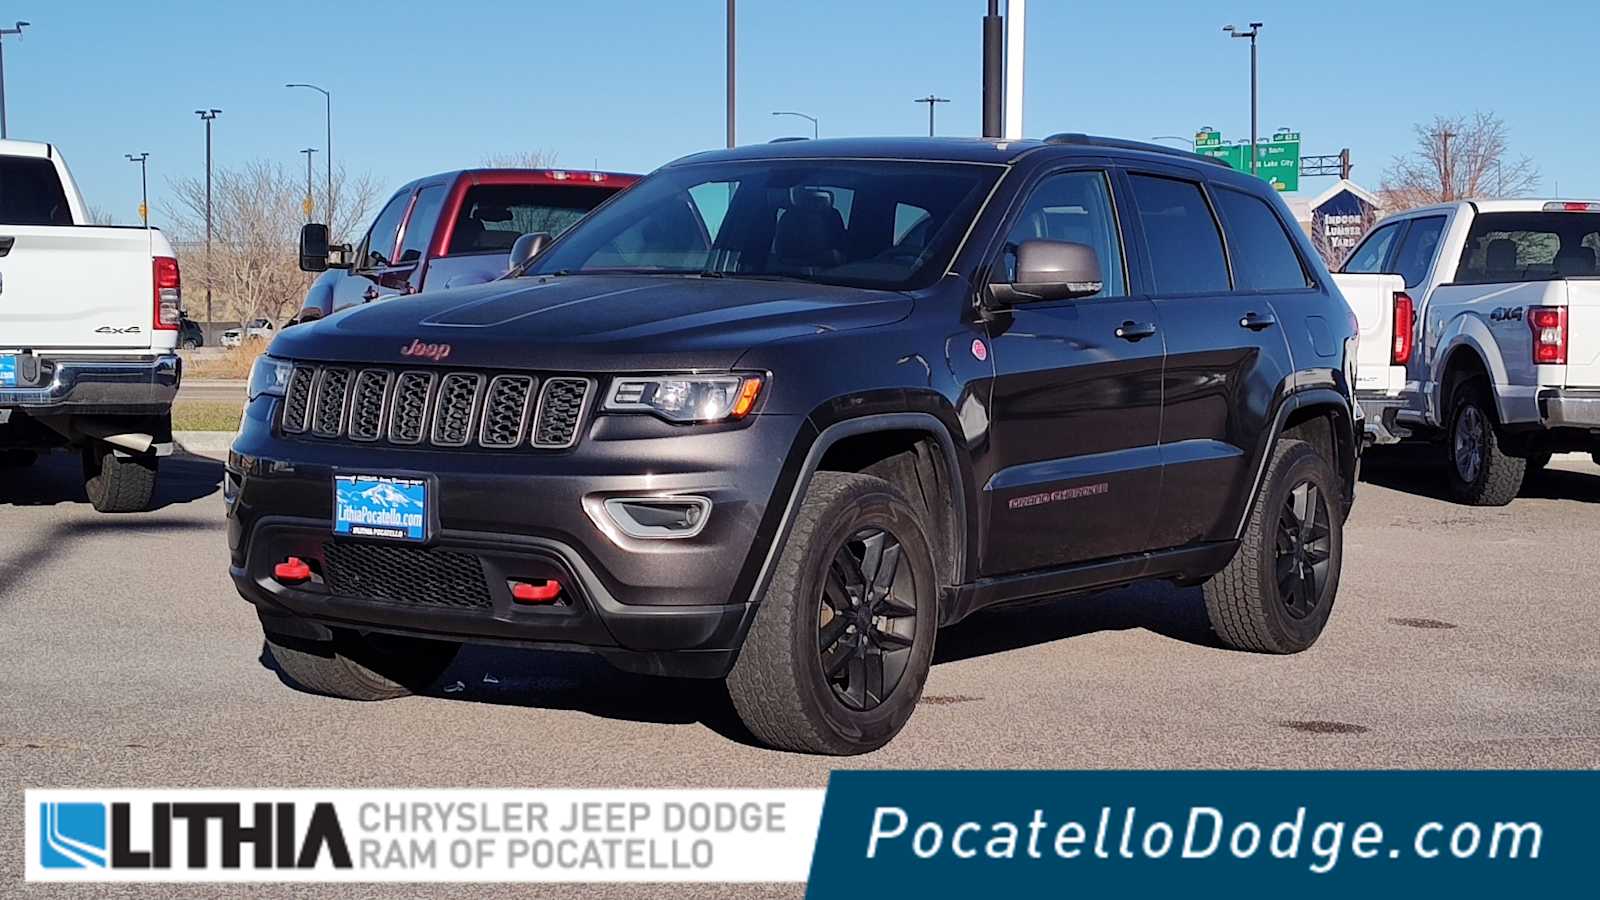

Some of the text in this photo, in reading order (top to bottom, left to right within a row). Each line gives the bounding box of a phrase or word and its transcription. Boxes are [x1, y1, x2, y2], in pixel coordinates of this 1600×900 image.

[1280, 159, 1294, 167] City
[1325, 214, 1361, 225] INDOOR
[1331, 236, 1356, 247] YARD
[400, 338, 451, 361] Jeep
[338, 503, 423, 527] LithiaPocatello.com
